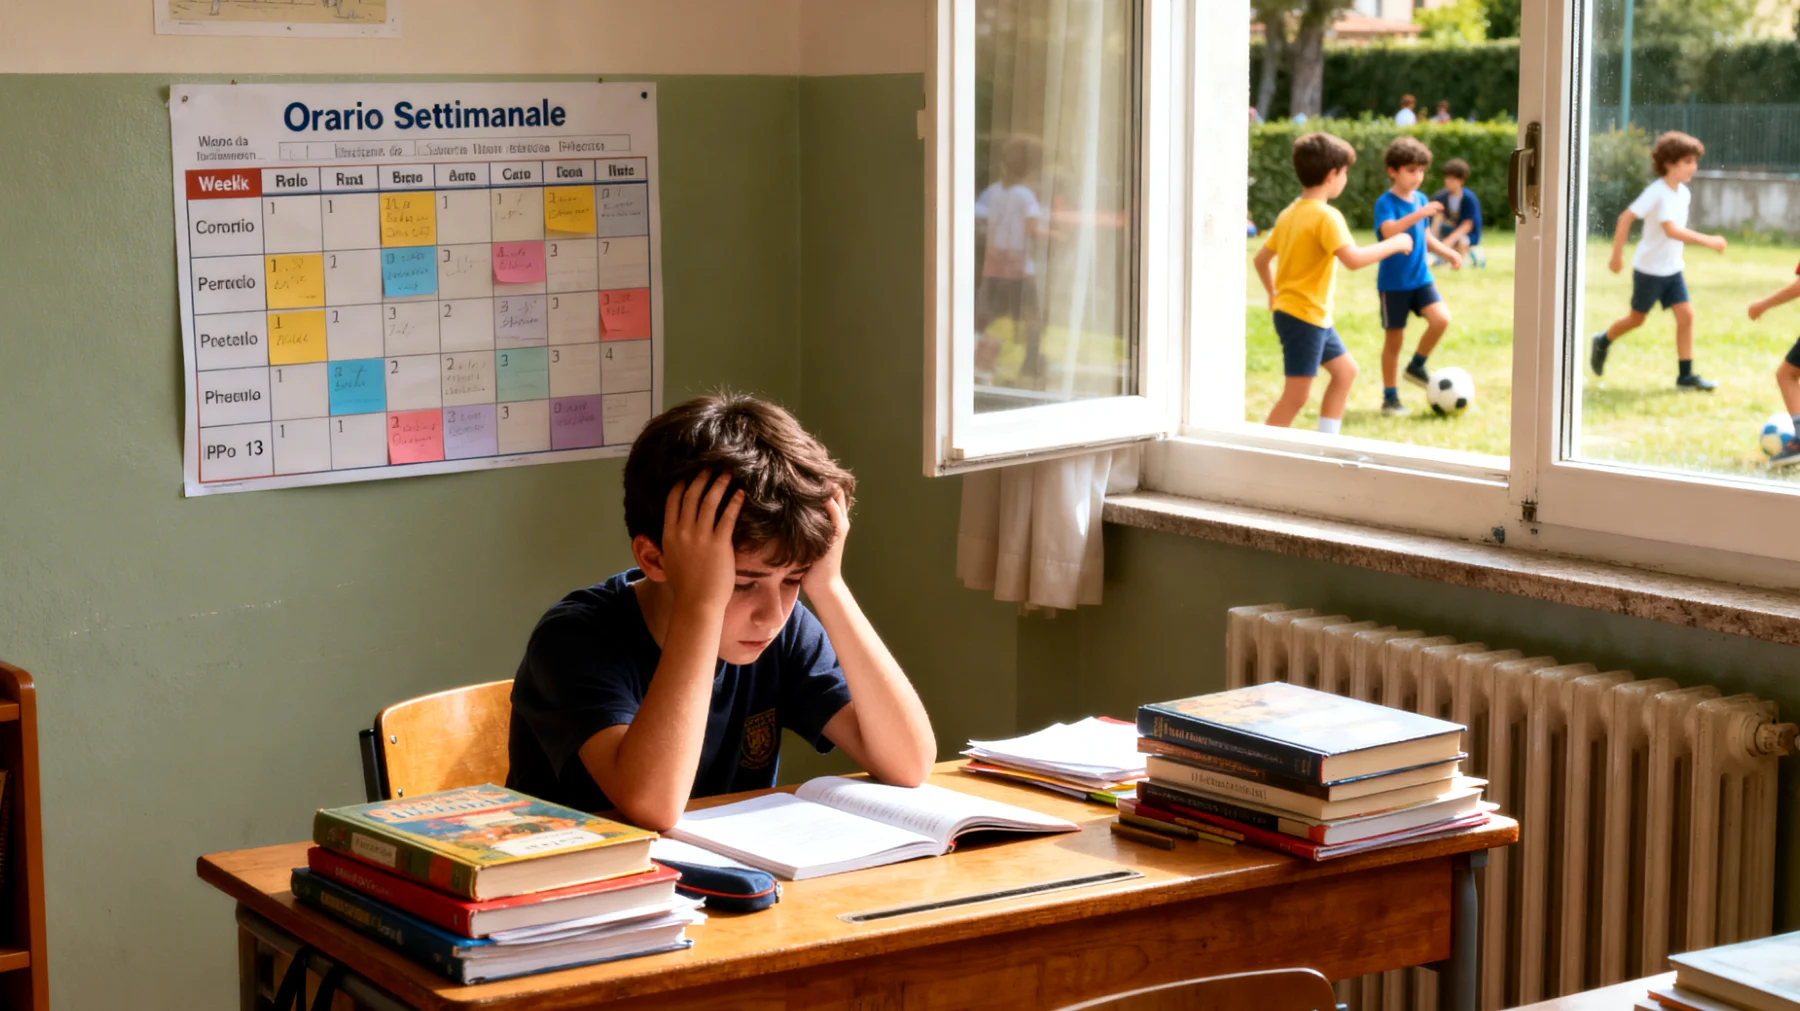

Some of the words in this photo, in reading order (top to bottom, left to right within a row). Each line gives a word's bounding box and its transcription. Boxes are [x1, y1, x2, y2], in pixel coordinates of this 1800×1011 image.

[284, 101, 384, 132] Orario
[394, 98, 566, 130] Settimanale
[328, 200, 334, 214] 1
[550, 244, 558, 257] 3
[602, 241, 610, 254] 7
[388, 307, 396, 320] 3
[444, 304, 452, 318] 2
[552, 350, 560, 363] 3
[605, 347, 613, 360] 4
[390, 360, 399, 374] 2
[447, 358, 454, 371] 2
[501, 354, 509, 367] 3
[276, 369, 283, 382] 1
[502, 406, 509, 419] 3
[280, 424, 285, 438] 1
[337, 420, 343, 433] 1
[246, 440, 263, 456] 13
